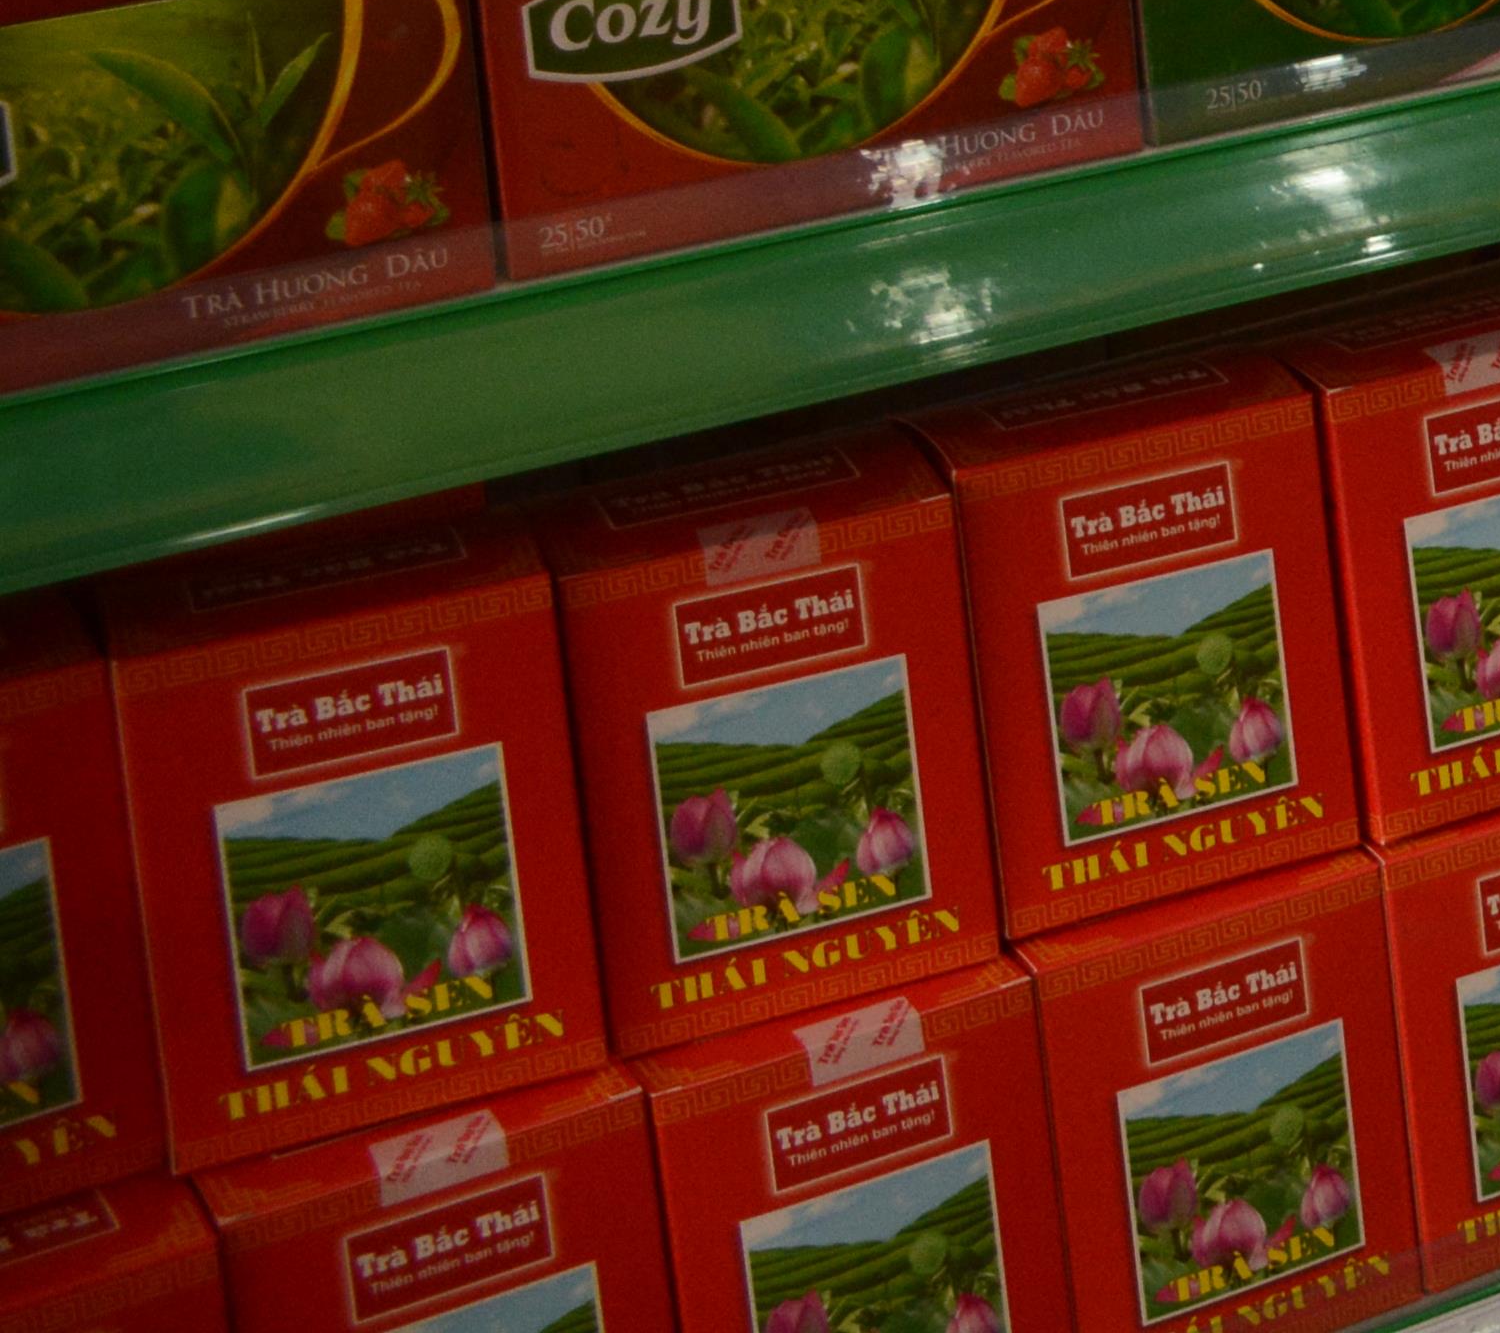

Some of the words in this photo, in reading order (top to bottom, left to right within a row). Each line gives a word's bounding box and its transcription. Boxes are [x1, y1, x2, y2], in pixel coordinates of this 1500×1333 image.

[1435, 432, 1472, 455] Trà
[1070, 512, 1113, 539] Trà
[685, 616, 731, 645] Trà
[256, 704, 308, 733] Trà
[1192, 761, 1267, 799] SEN
[816, 874, 896, 916] SEN
[403, 975, 494, 1019] SEN
